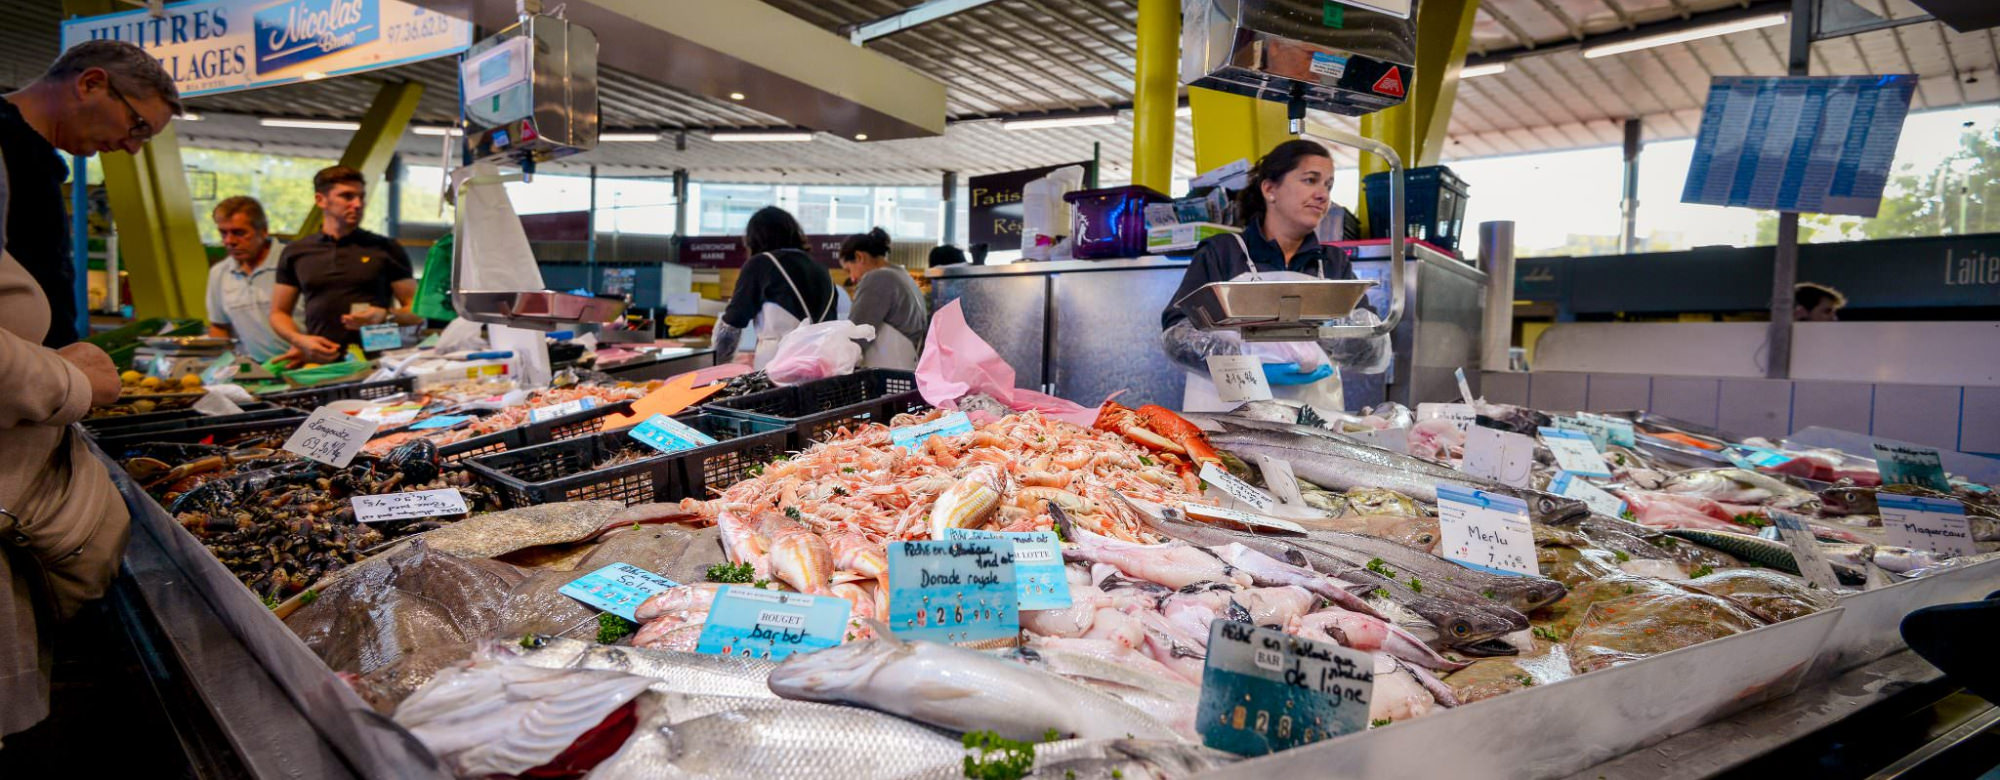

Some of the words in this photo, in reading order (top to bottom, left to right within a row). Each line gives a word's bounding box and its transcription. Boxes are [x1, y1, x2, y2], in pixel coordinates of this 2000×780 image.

[269, 0, 363, 51] Nicolas
[1468, 525, 1508, 546] Merlu
[920, 568, 961, 589] Dorade
[967, 574, 1000, 590] royale
[760, 612, 802, 625] ROUGET
[1256, 653, 1281, 667] BAR
[1284, 660, 1309, 689] de
